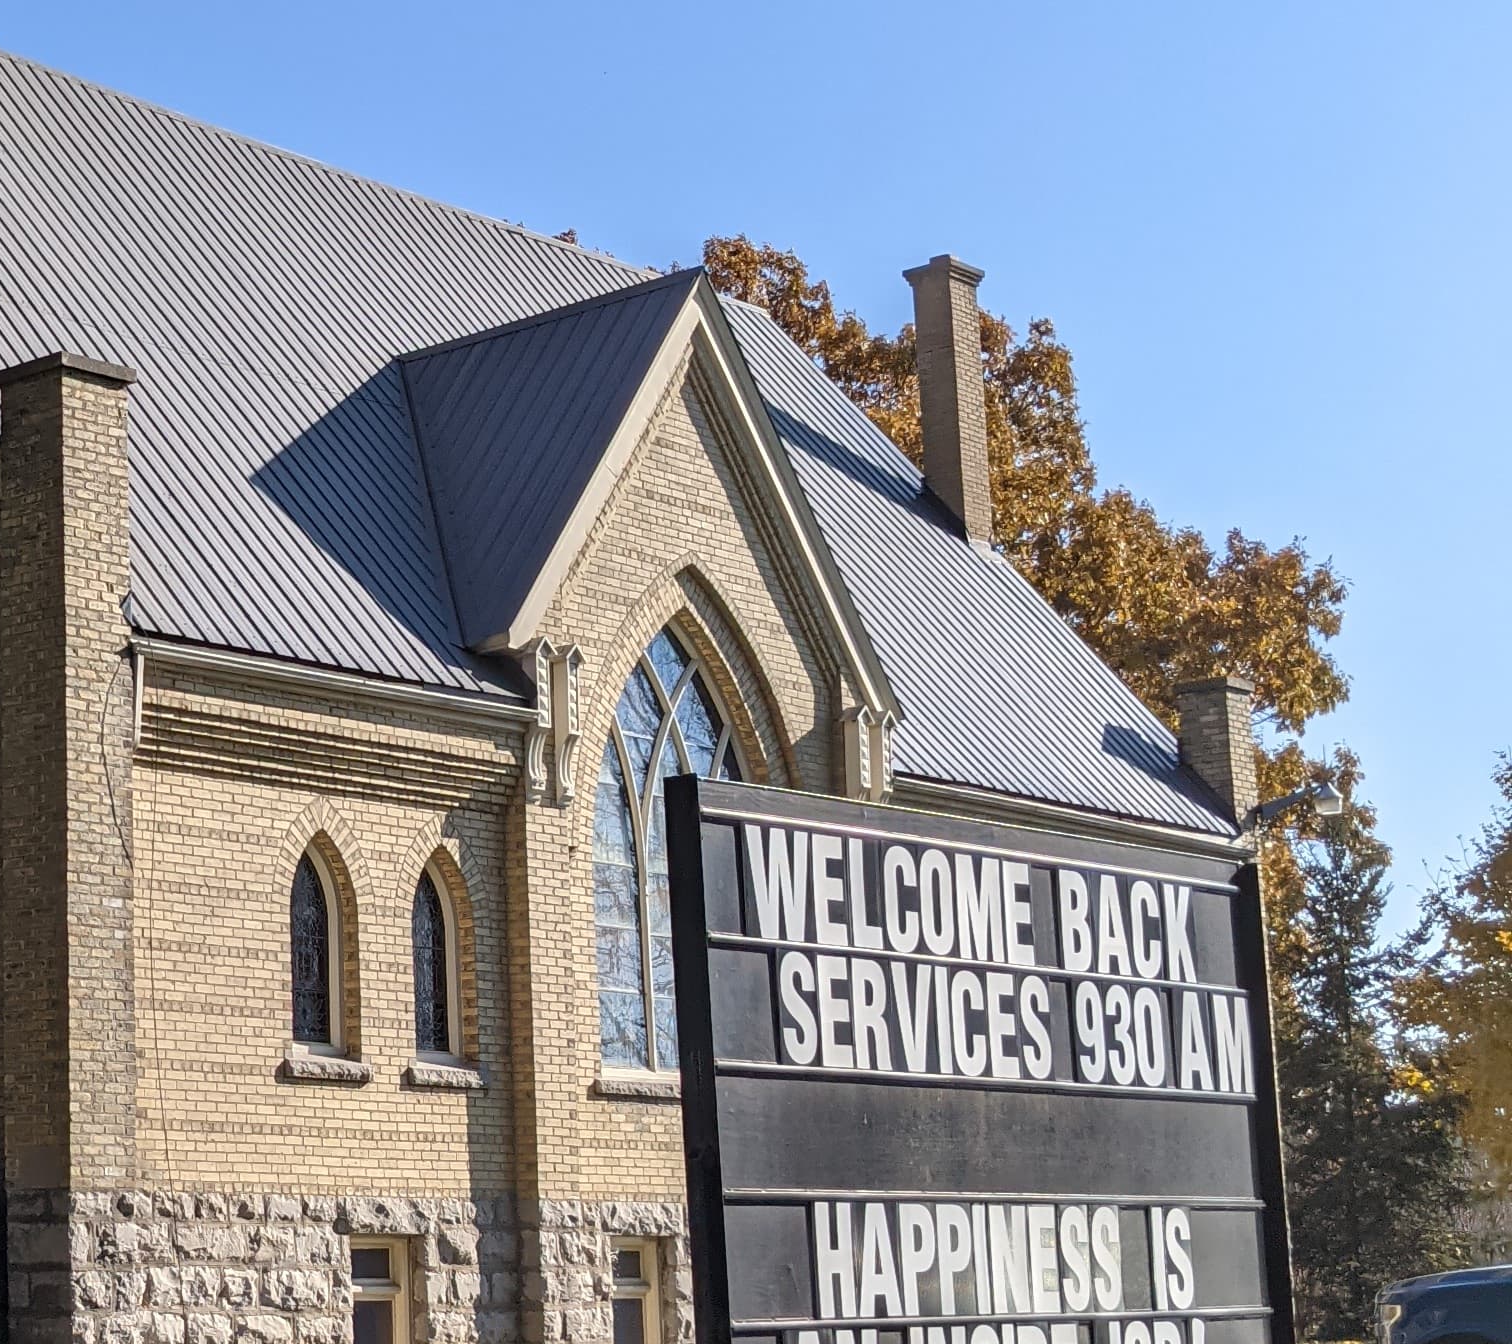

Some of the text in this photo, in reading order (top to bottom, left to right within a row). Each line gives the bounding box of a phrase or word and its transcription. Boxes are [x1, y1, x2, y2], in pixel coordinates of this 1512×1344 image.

[744, 824, 1197, 983] WELCOME BACK
[778, 950, 1255, 1094] SERVICES 930 AM
[815, 1202, 1194, 1318] HAPPINESS IS
